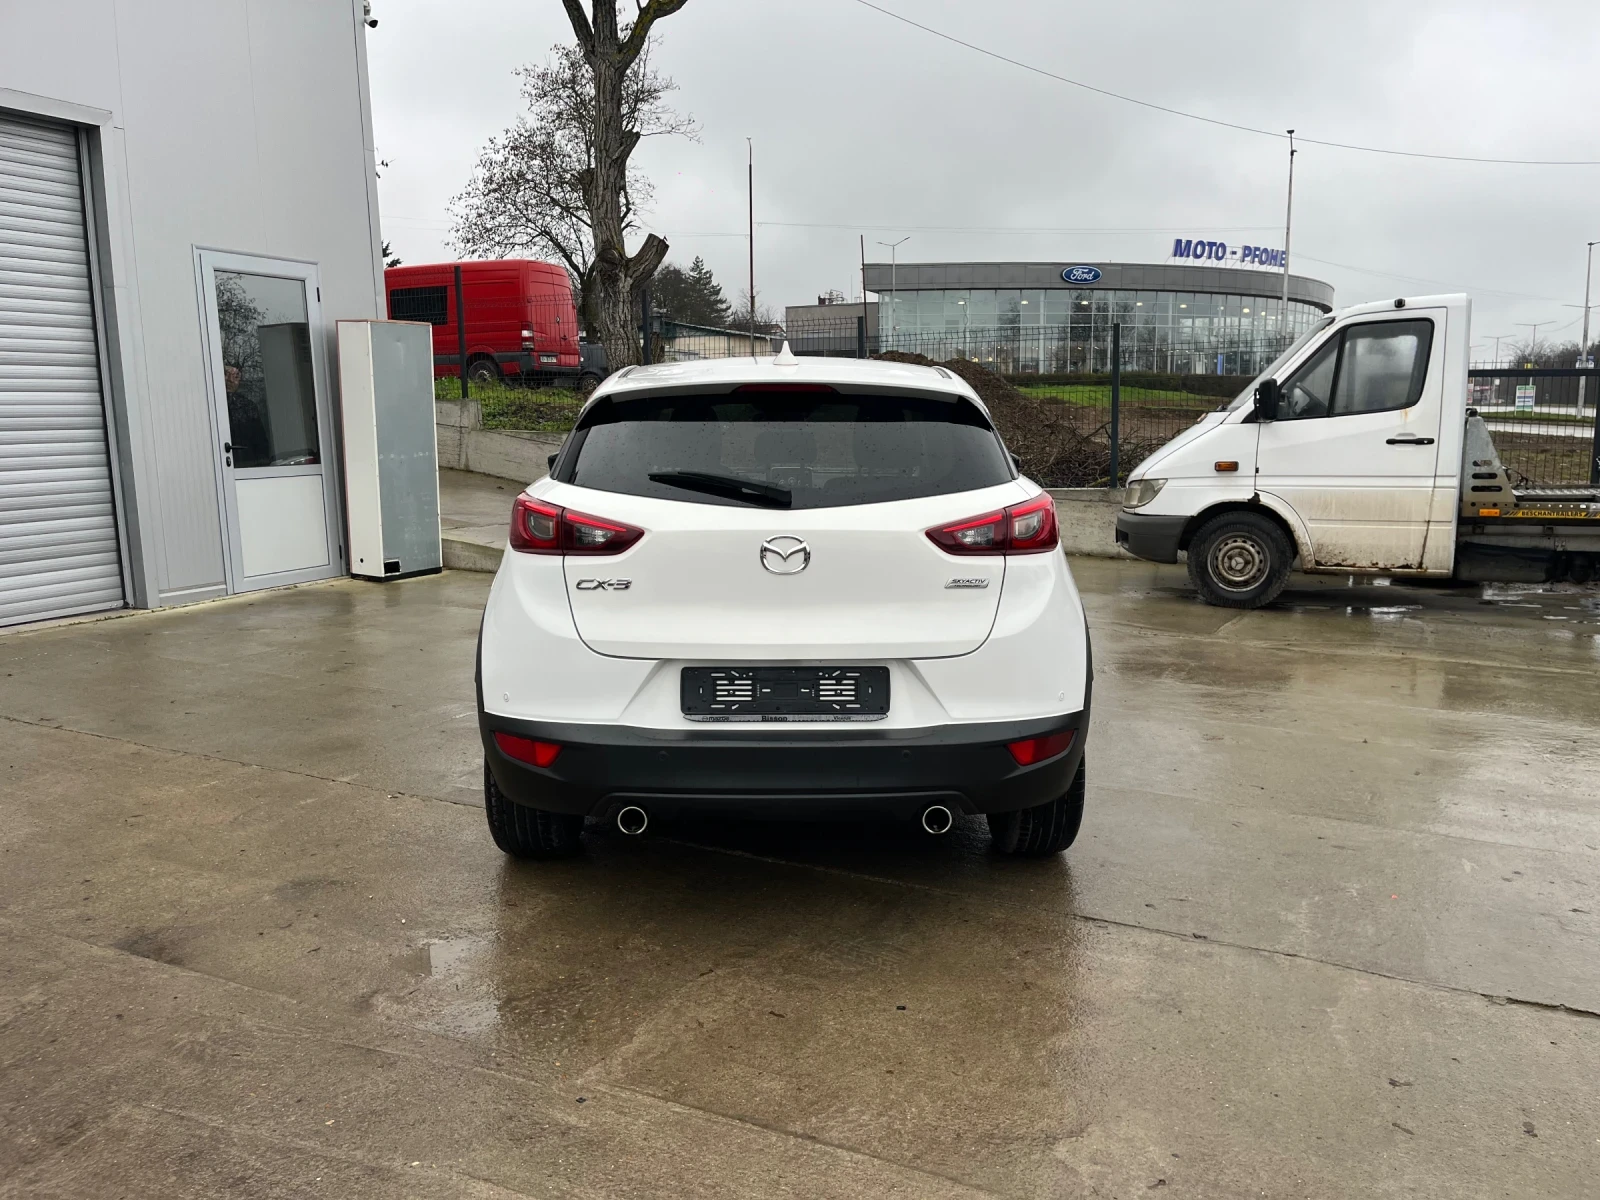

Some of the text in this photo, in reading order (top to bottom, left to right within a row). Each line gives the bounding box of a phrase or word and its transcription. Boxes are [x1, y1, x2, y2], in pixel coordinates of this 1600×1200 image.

[1172, 238, 1227, 261] MOTO
[1070, 268, 1095, 280] Ford
[575, 577, 632, 590] CX-3
